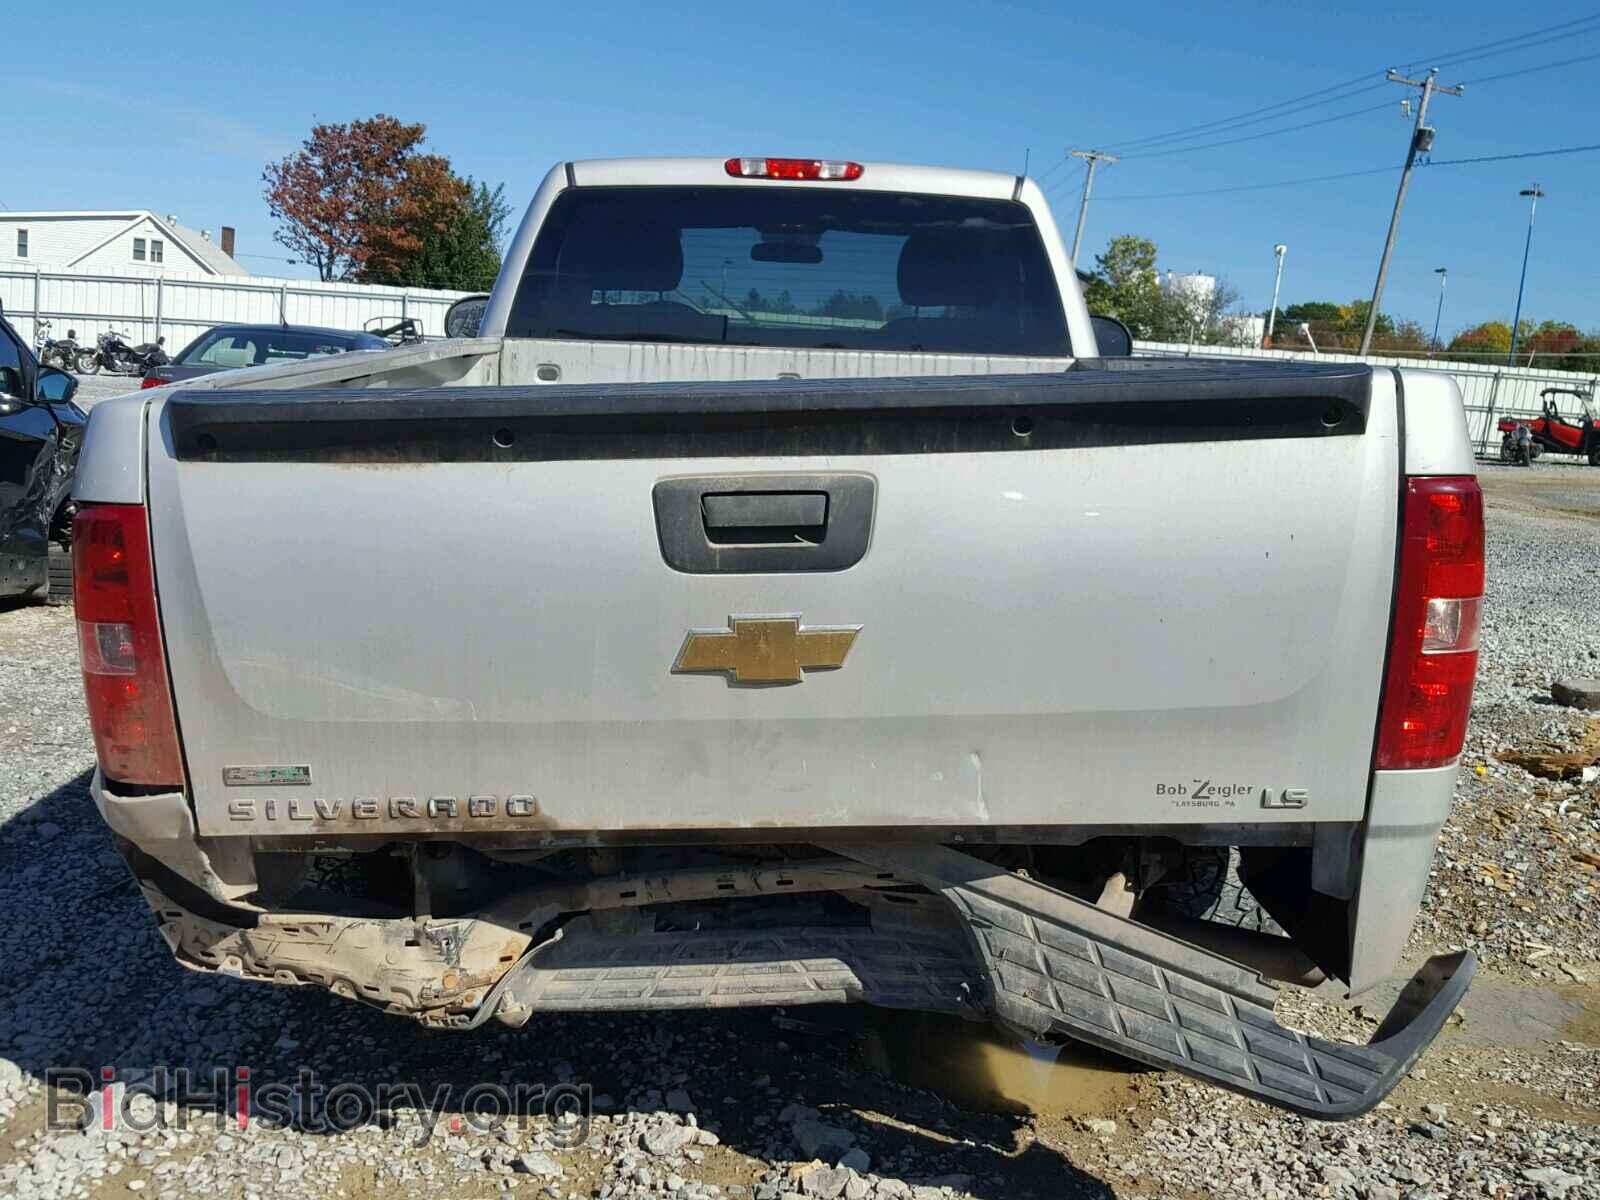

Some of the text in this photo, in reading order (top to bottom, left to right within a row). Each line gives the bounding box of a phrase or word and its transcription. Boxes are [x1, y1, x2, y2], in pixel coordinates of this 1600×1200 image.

[1156, 783, 1187, 795] Bob
[1260, 788, 1309, 809] LS
[228, 793, 537, 821] SILVERADO
